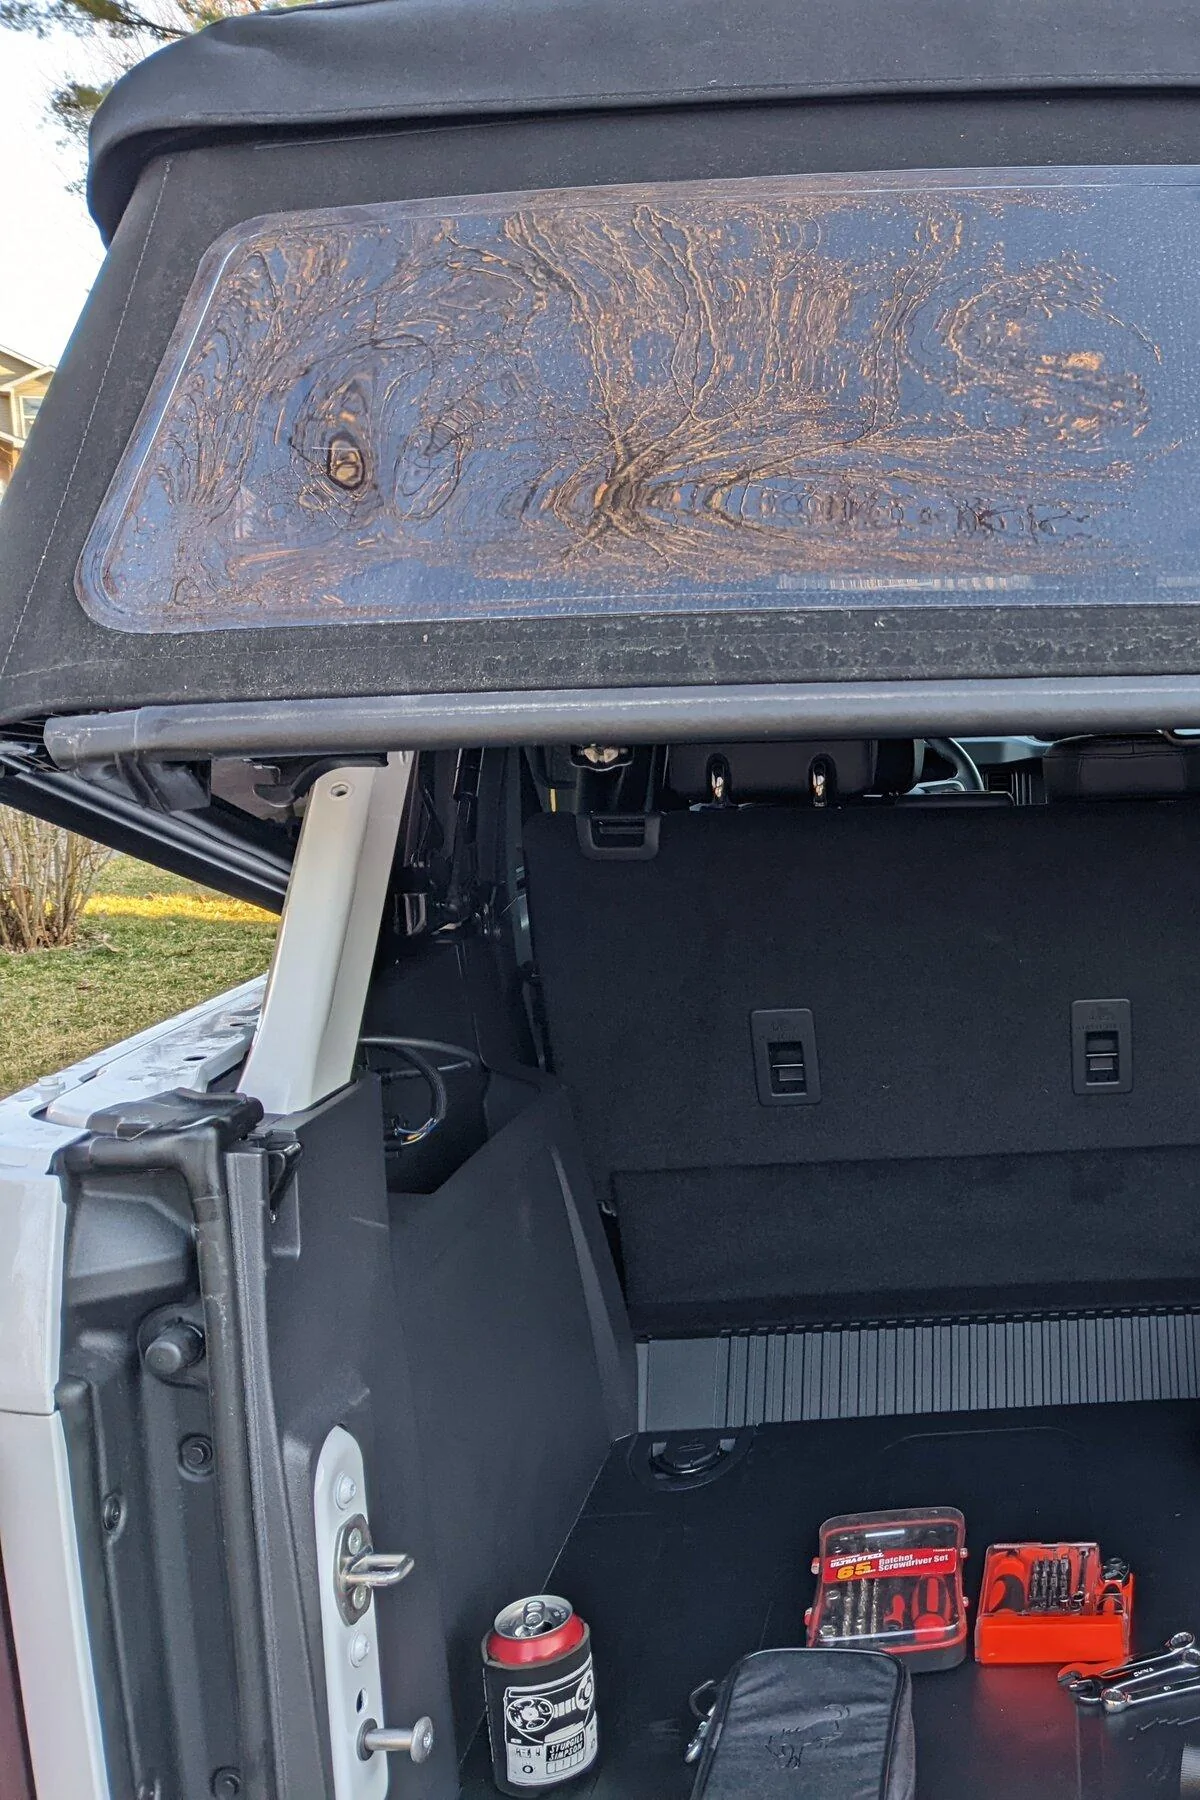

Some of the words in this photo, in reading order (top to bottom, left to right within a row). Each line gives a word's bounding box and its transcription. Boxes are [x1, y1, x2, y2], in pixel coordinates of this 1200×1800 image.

[878, 1557, 932, 1572] Screwdriver
[933, 1553, 949, 1562] Set
[879, 1554, 914, 1566] Ratchet
[836, 1561, 872, 1580] 65
[549, 1742, 583, 1761] SIMPSON
[550, 1731, 584, 1754] STURGILL
